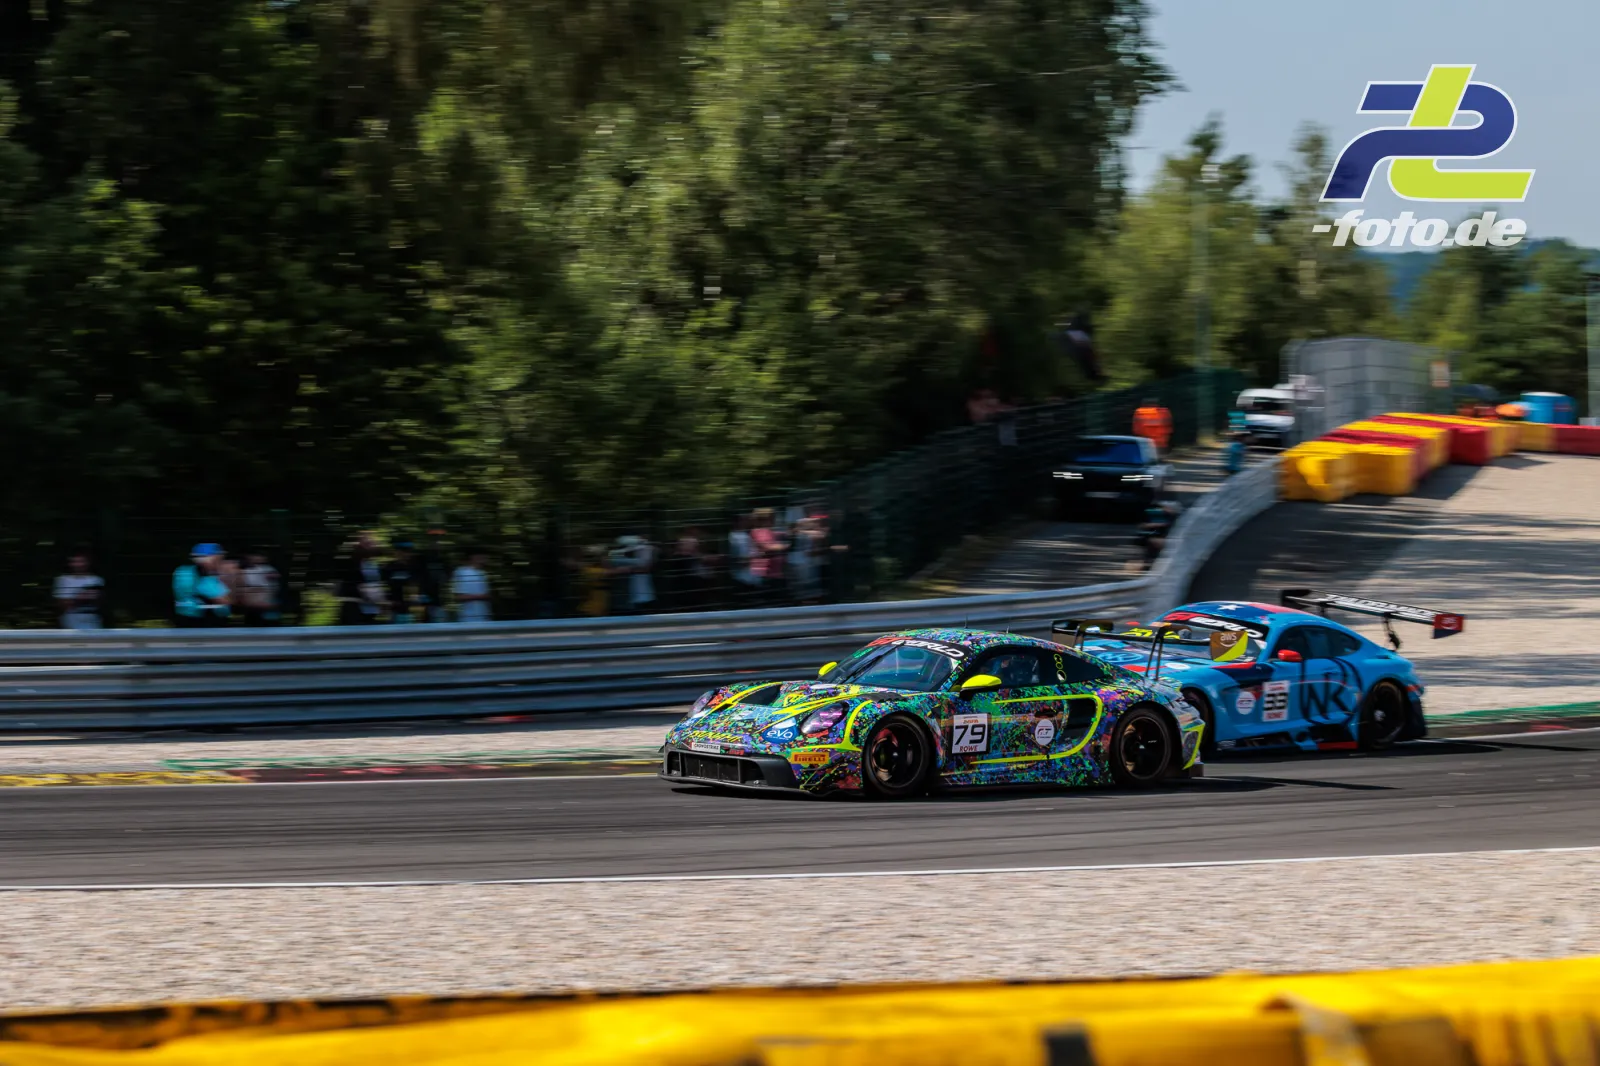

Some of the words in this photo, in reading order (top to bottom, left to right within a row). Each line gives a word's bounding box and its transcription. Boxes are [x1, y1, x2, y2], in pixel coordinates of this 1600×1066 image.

[1220, 632, 1237, 641] aws
[954, 723, 986, 746] 79
[794, 753, 826, 762] PIRELLI
